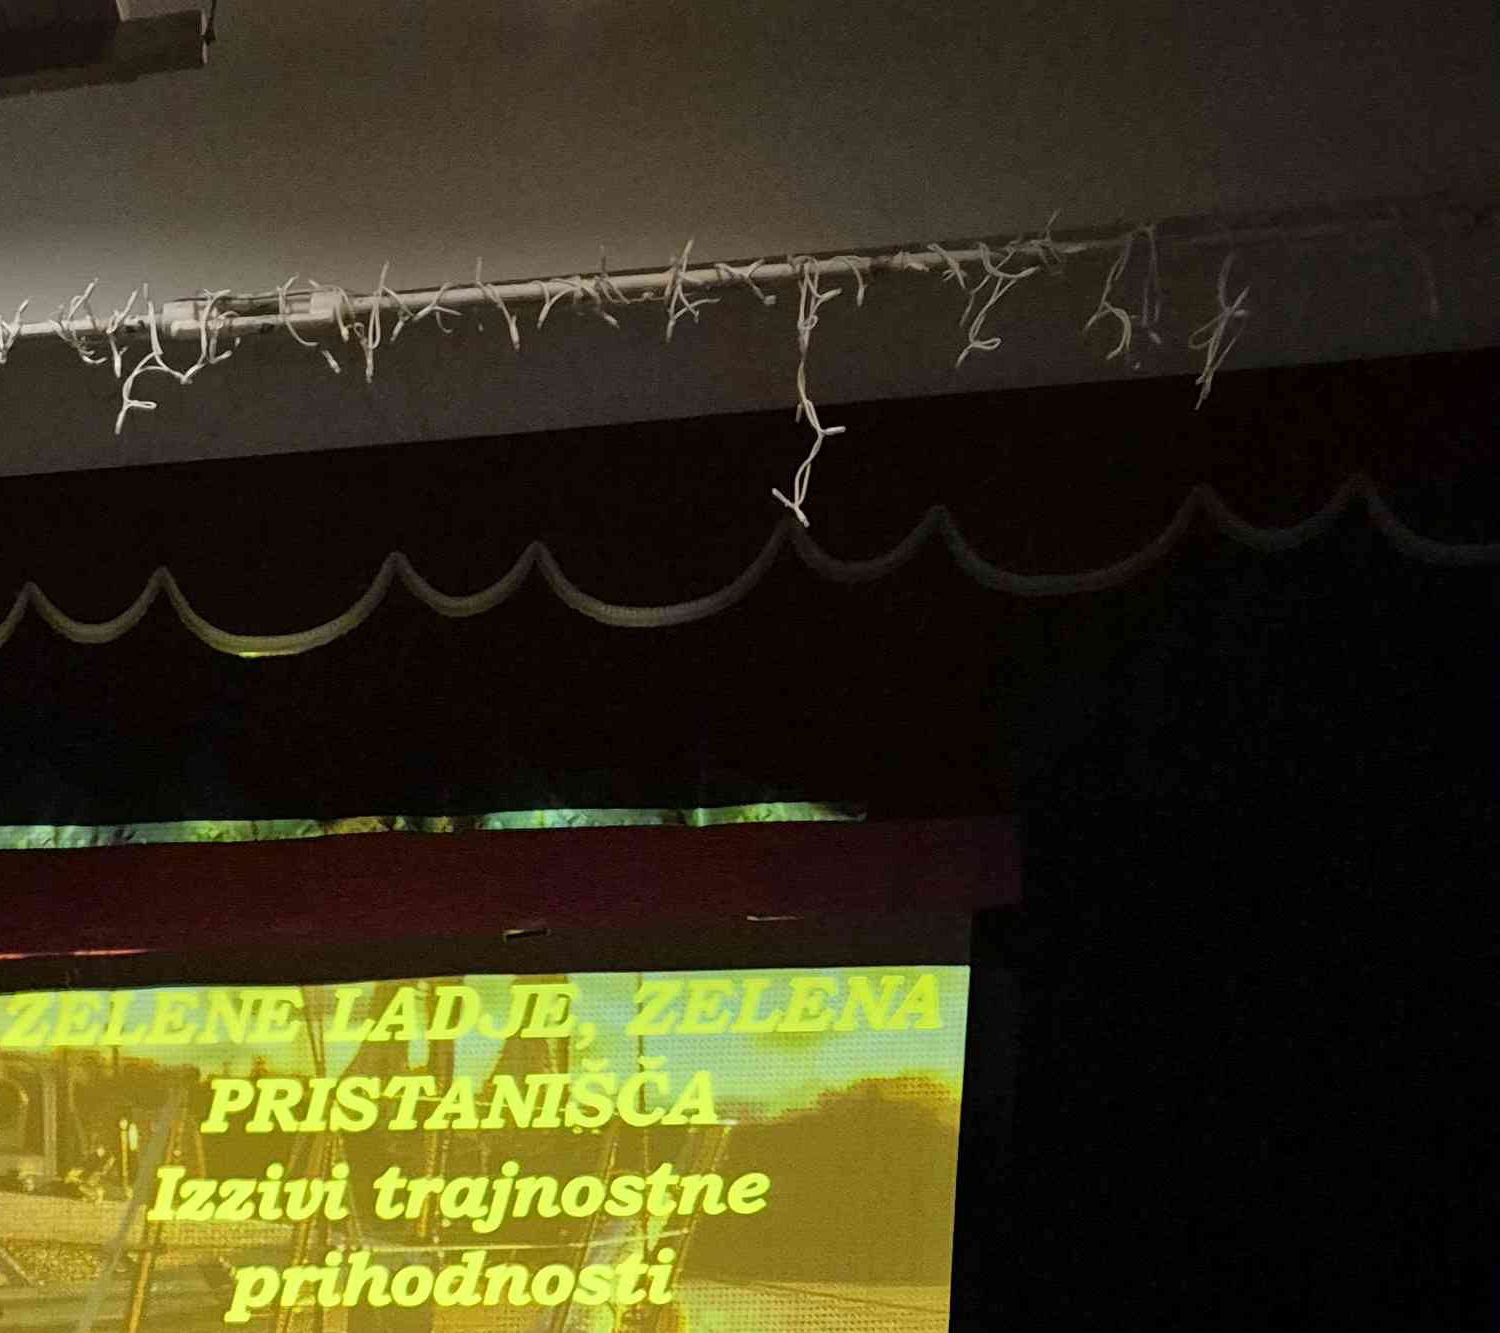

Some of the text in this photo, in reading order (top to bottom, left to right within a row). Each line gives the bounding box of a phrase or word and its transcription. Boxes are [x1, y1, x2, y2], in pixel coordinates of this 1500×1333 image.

[1, 974, 943, 1050] ZELENE LADJE, ZELENA
[202, 1057, 720, 1132] PRISTANIŠČA
[148, 1161, 772, 1235] Izzivi trajnostne
[225, 1248, 677, 1323] prihodnosti
